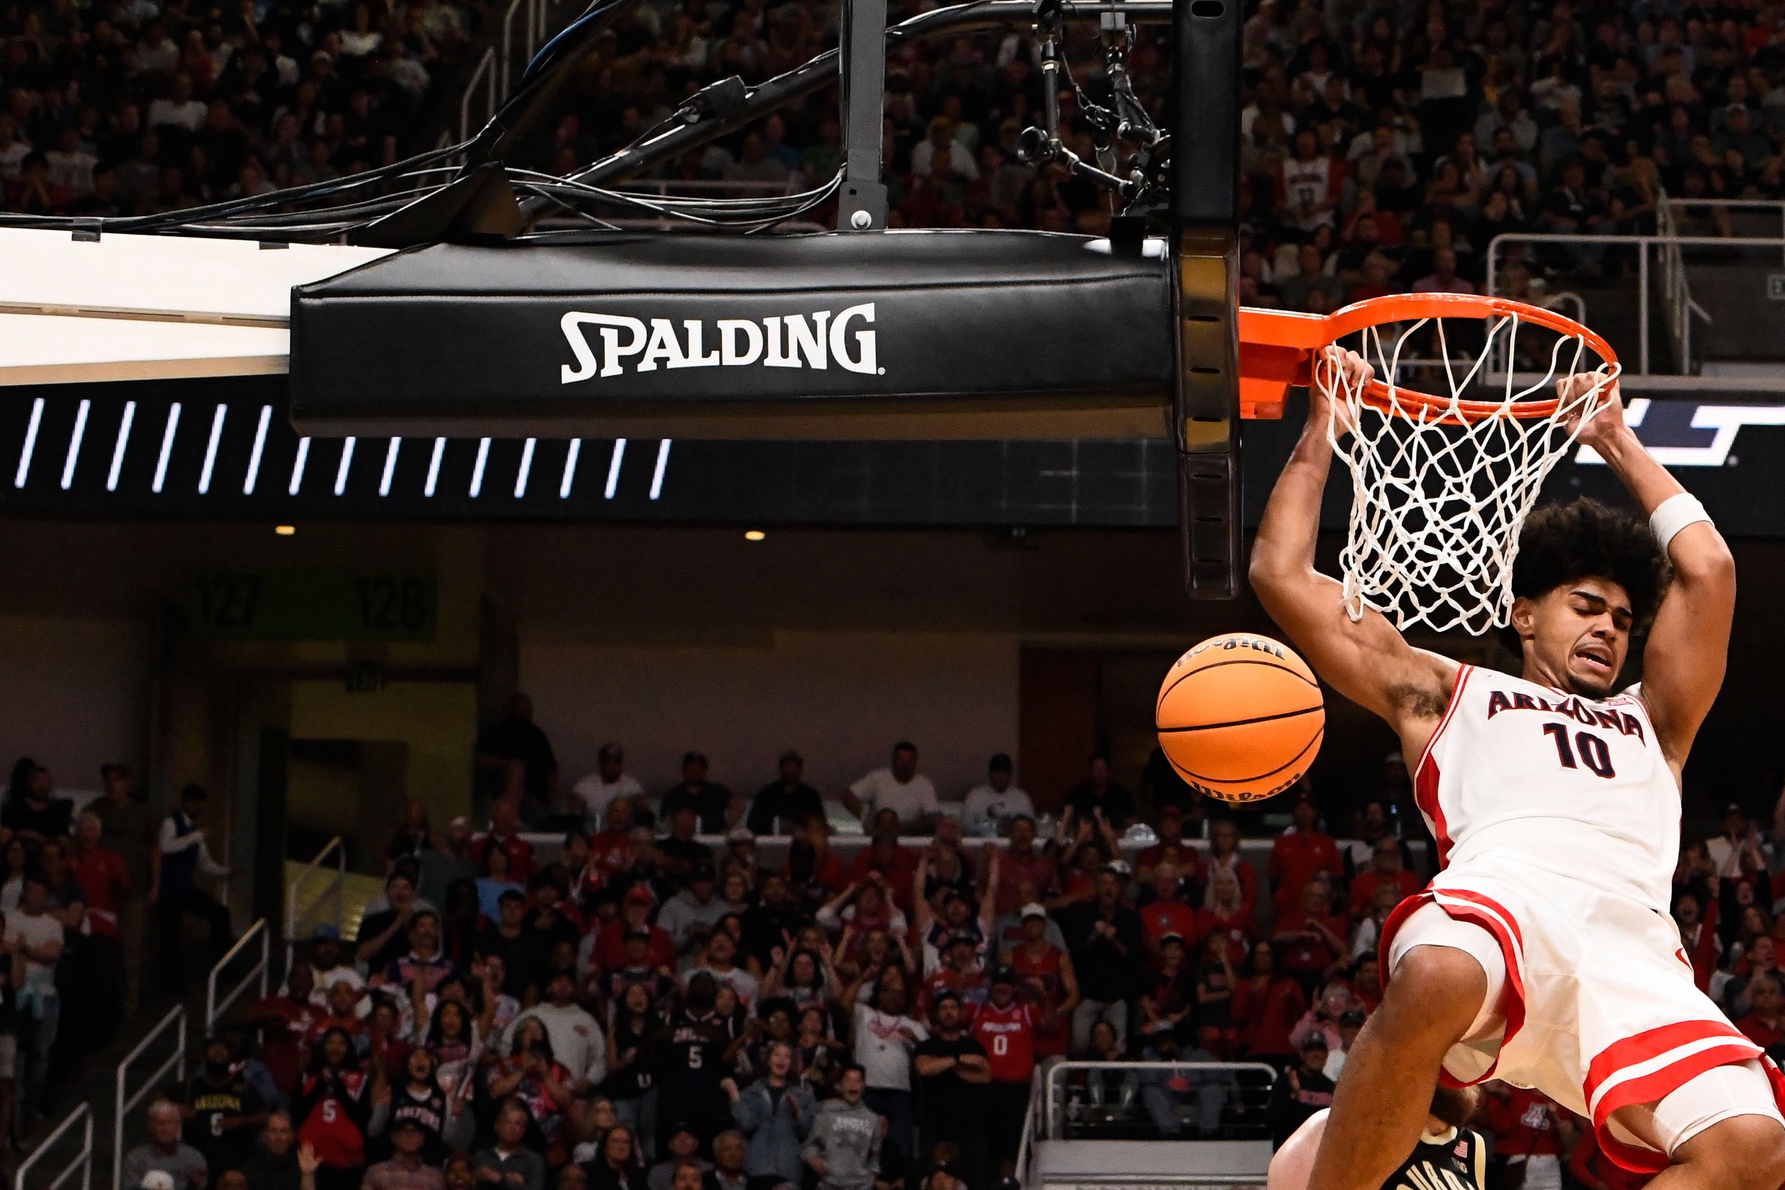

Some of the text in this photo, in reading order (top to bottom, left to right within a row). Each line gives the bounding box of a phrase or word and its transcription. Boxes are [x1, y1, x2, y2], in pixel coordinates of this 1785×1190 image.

[561, 302, 877, 385] SPALDING
[194, 574, 261, 627] 127
[355, 576, 427, 629] 128
[1487, 690, 1647, 748] ARIZONA
[1542, 722, 1616, 780] 10
